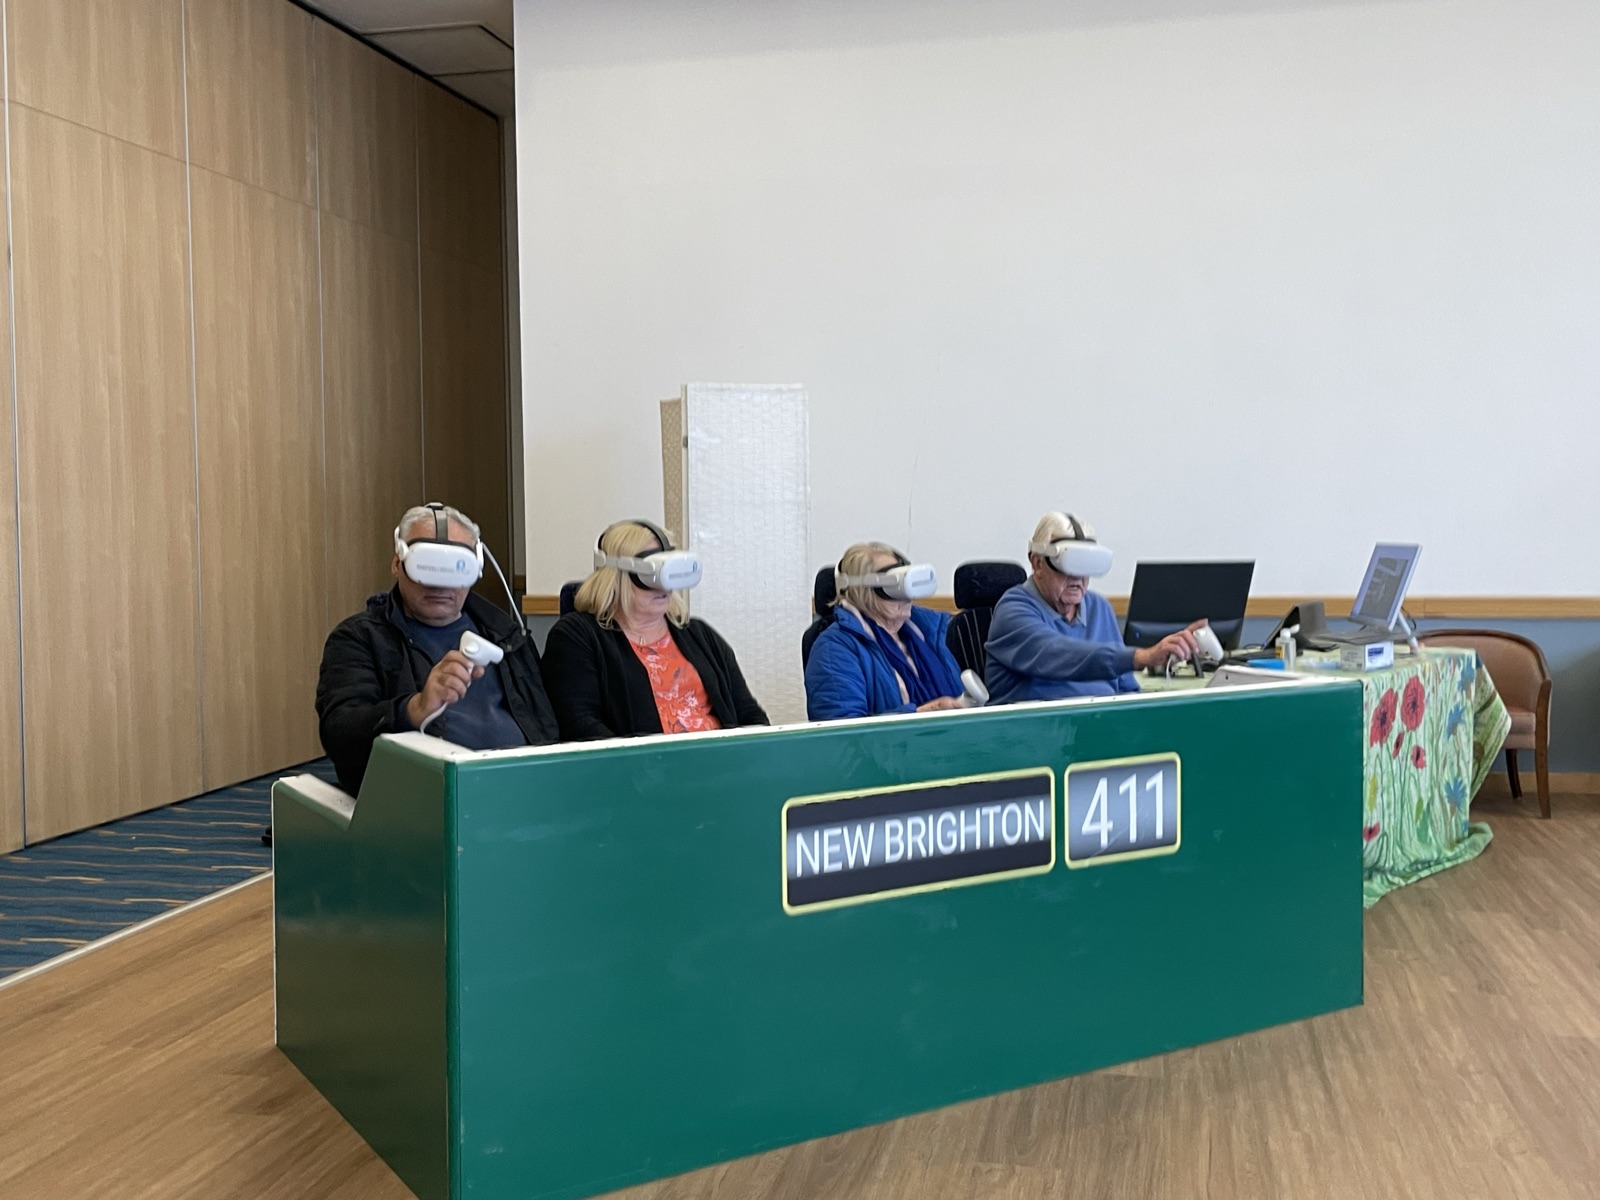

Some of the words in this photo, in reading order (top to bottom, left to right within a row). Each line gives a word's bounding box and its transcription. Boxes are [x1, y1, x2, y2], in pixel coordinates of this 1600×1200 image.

[795, 822, 875, 877] NEW
[884, 800, 1046, 864] BRIGHTON
[1081, 769, 1165, 848] 411
